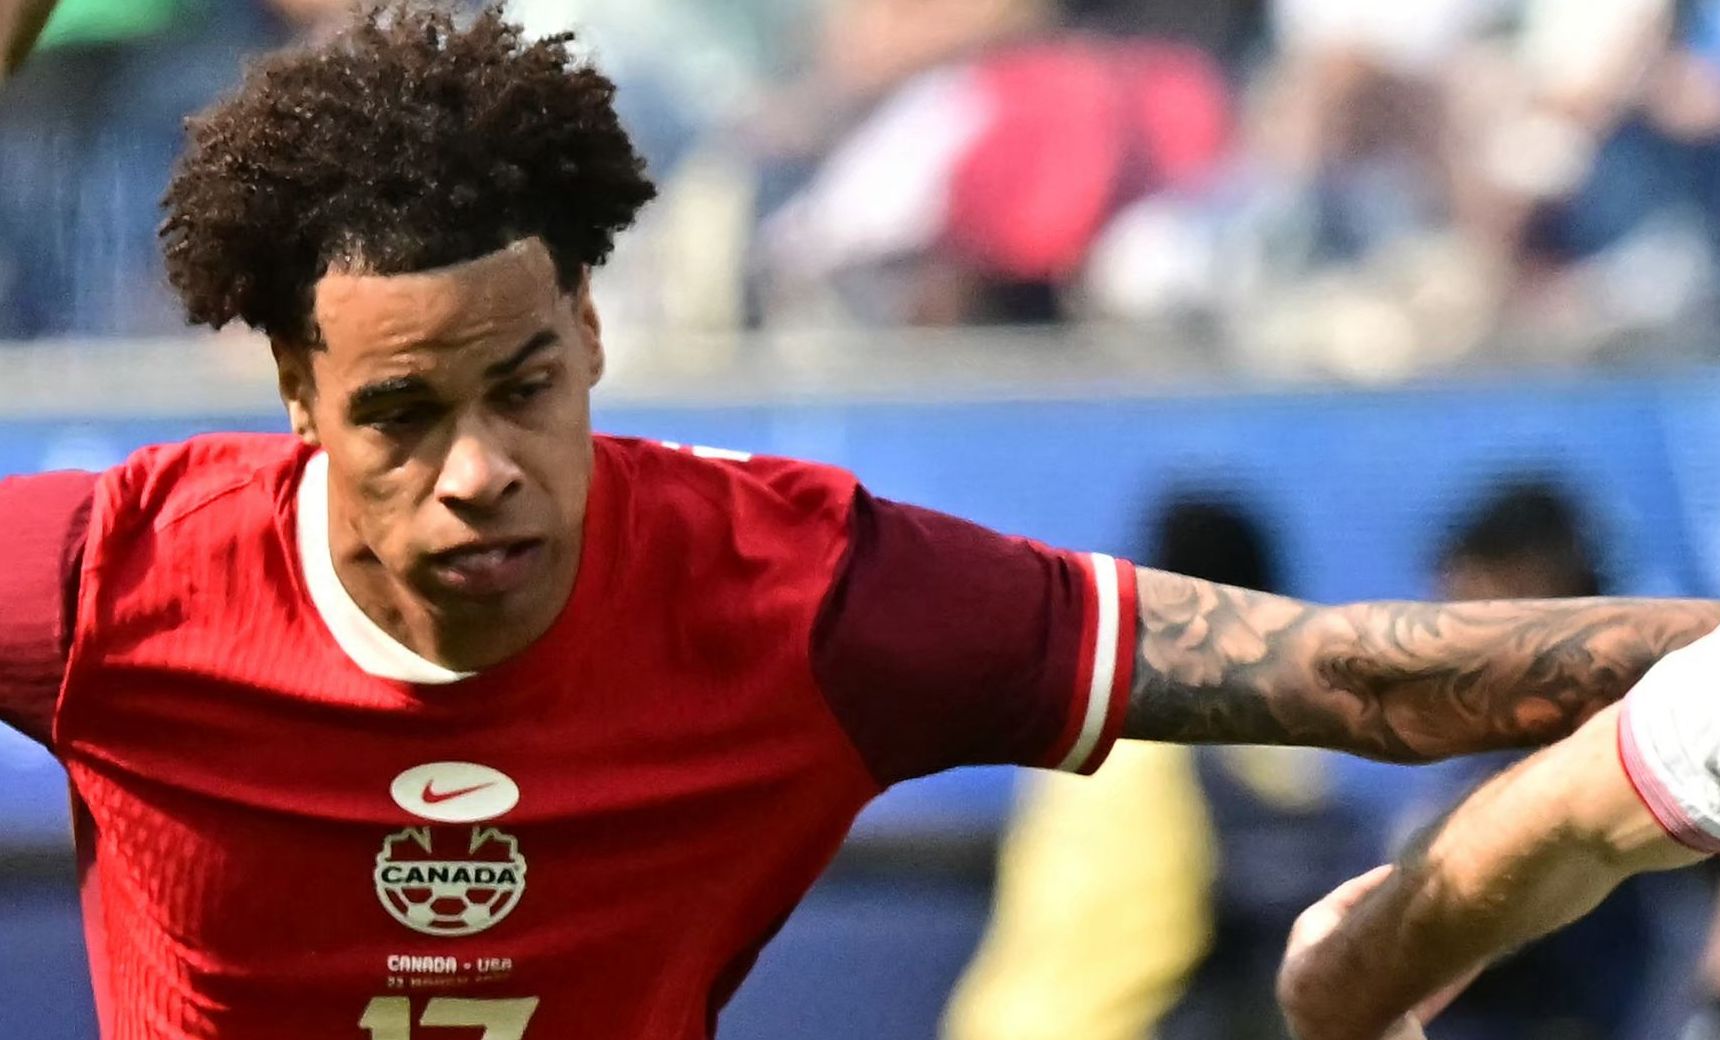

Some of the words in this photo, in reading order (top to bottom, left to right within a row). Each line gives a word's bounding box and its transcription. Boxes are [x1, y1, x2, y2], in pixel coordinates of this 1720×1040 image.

[381, 866, 516, 884] CANADA
[387, 954, 457, 974] CANADA
[477, 957, 513, 972] USA
